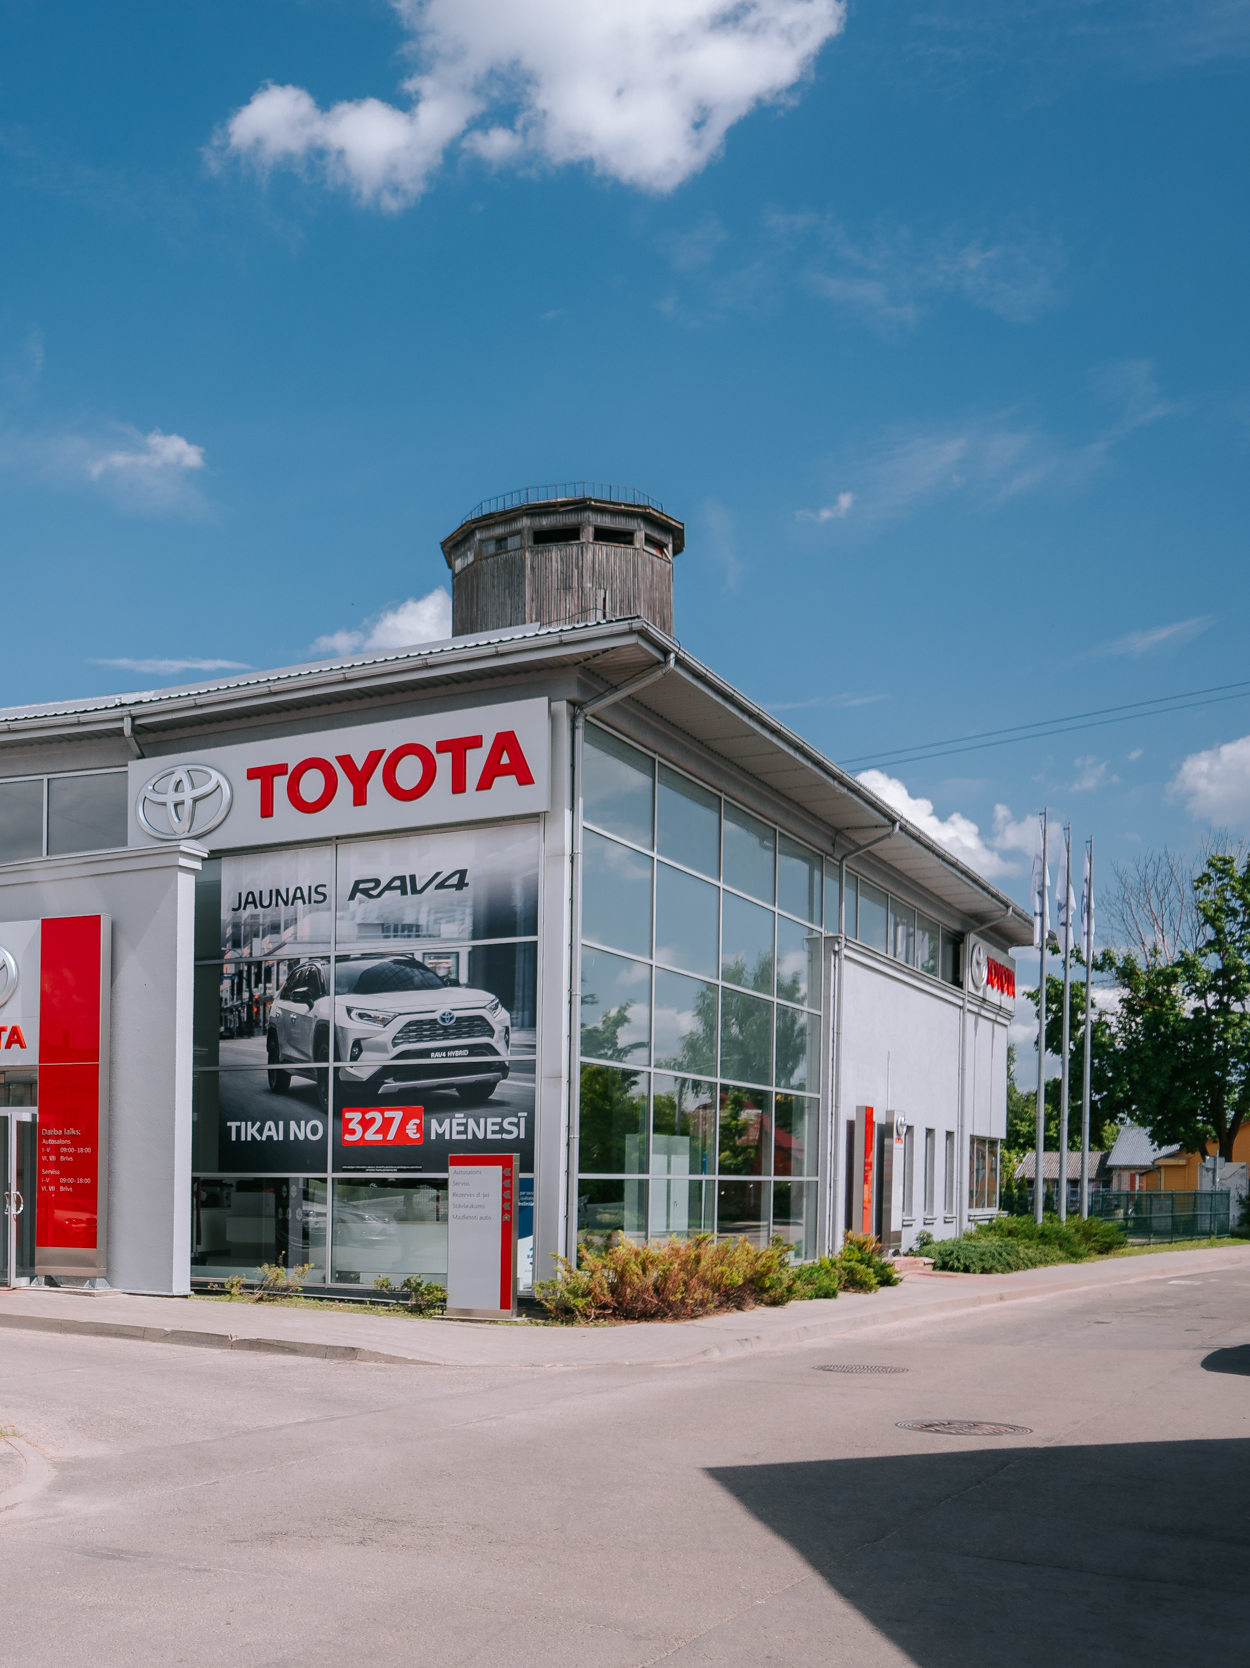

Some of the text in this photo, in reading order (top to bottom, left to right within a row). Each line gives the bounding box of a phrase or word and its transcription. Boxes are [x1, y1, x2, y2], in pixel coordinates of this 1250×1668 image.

[246, 730, 536, 819] TOYOTA
[231, 868, 470, 913] JAUNAIS RAV4
[227, 1110, 528, 1142] TIKAI NO 327€ MĒNESĪ
